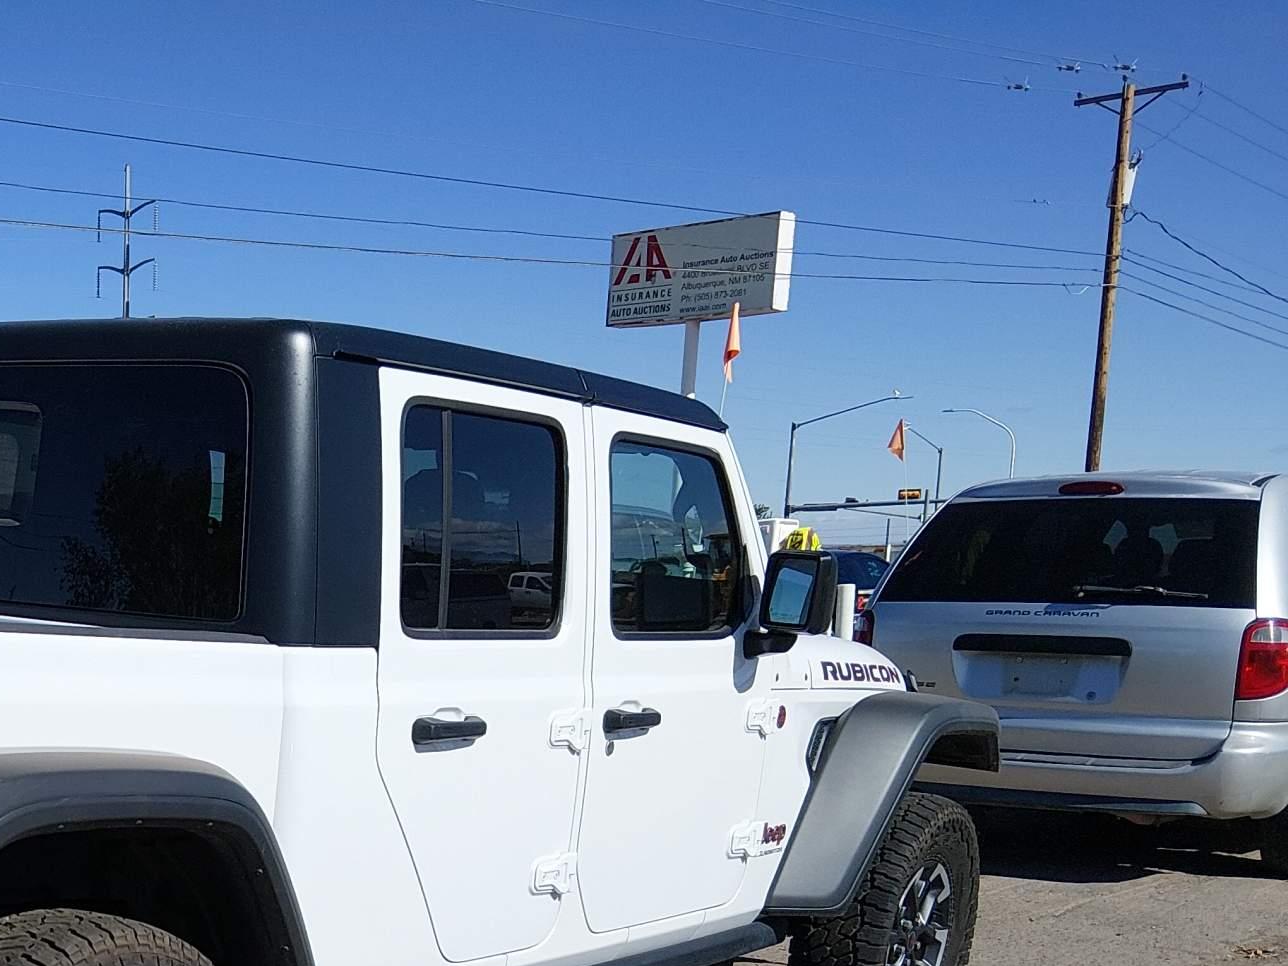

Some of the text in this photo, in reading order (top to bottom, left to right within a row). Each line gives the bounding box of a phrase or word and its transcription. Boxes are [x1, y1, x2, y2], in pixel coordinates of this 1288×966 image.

[682, 251, 774, 269] Insurance Auto Auctions
[758, 261, 769, 269] SE
[611, 288, 672, 303] INSURANCE
[610, 303, 671, 318] AUTO AUCTIONS
[820, 661, 901, 684] RUBICON
[761, 822, 786, 846] Jeep
